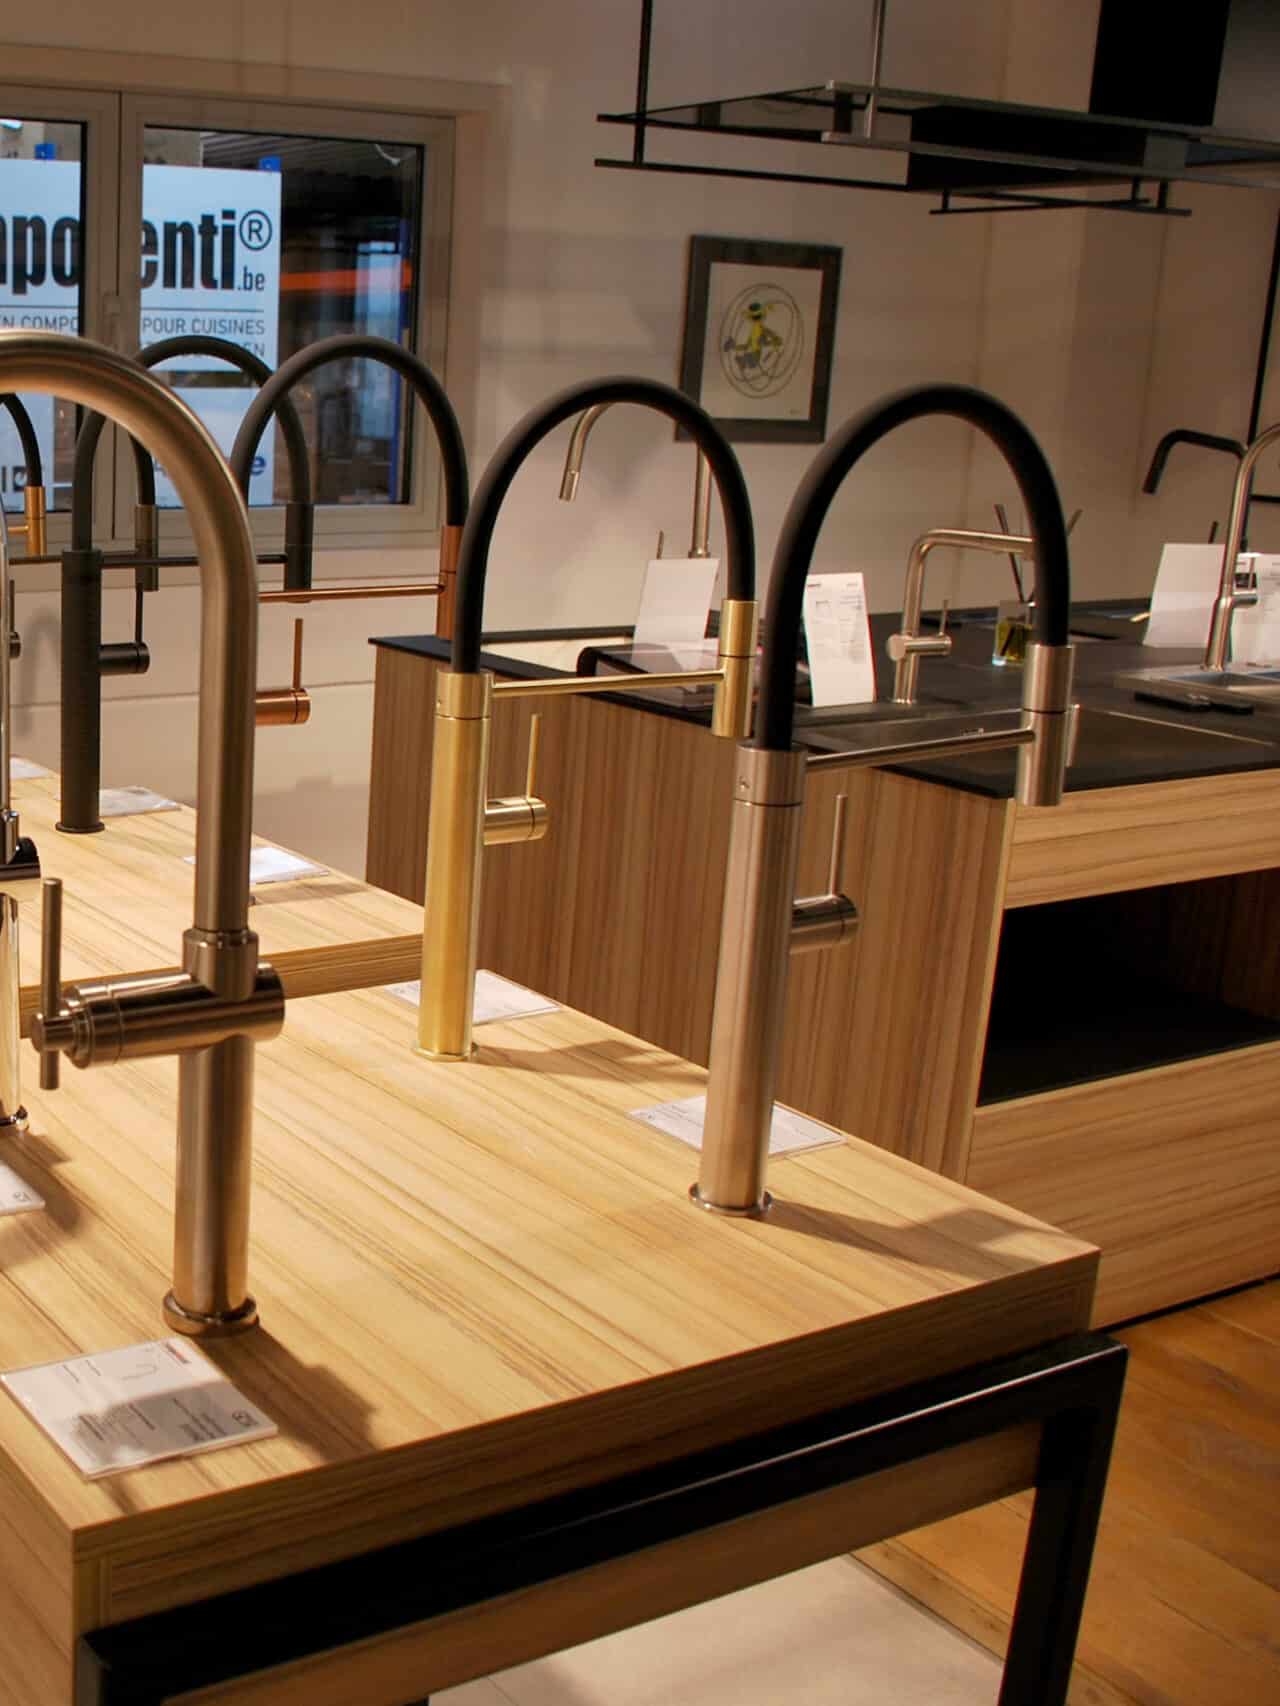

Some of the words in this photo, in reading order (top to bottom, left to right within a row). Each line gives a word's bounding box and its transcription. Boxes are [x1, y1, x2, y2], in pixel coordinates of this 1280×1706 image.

[20, 315, 79, 333] COMPO
[142, 317, 187, 334] POUR
[191, 318, 265, 335] CUISINES
